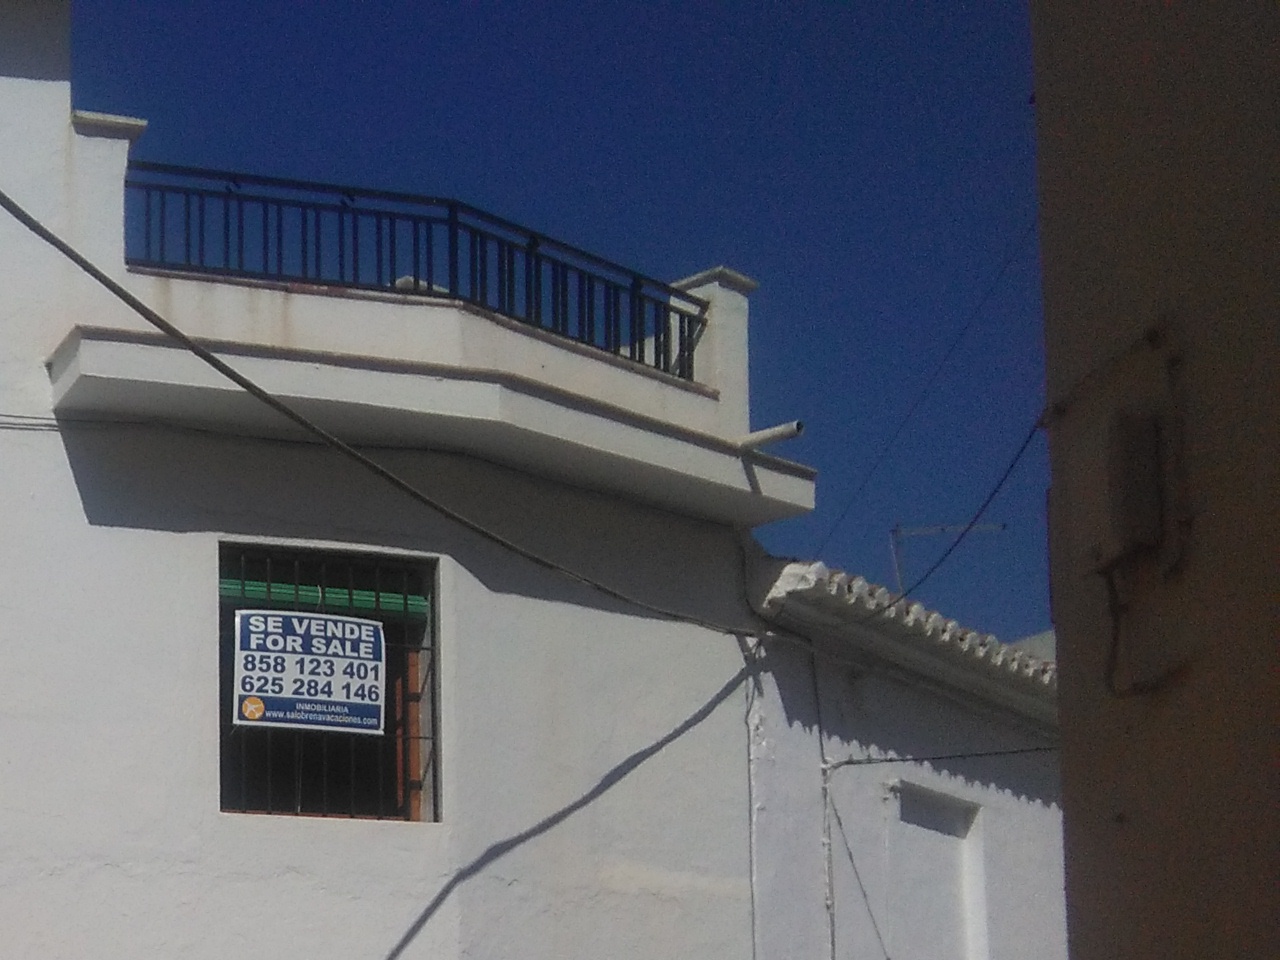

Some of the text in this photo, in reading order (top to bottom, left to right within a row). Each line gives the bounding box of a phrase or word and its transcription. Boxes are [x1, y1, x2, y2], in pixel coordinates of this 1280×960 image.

[249, 616, 375, 642] SE VENDE
[250, 634, 374, 659] FOR SALE
[243, 654, 380, 681] 858 123 401
[241, 675, 380, 702] 625 284 146
[296, 702, 349, 714] INMOBILIARIA
